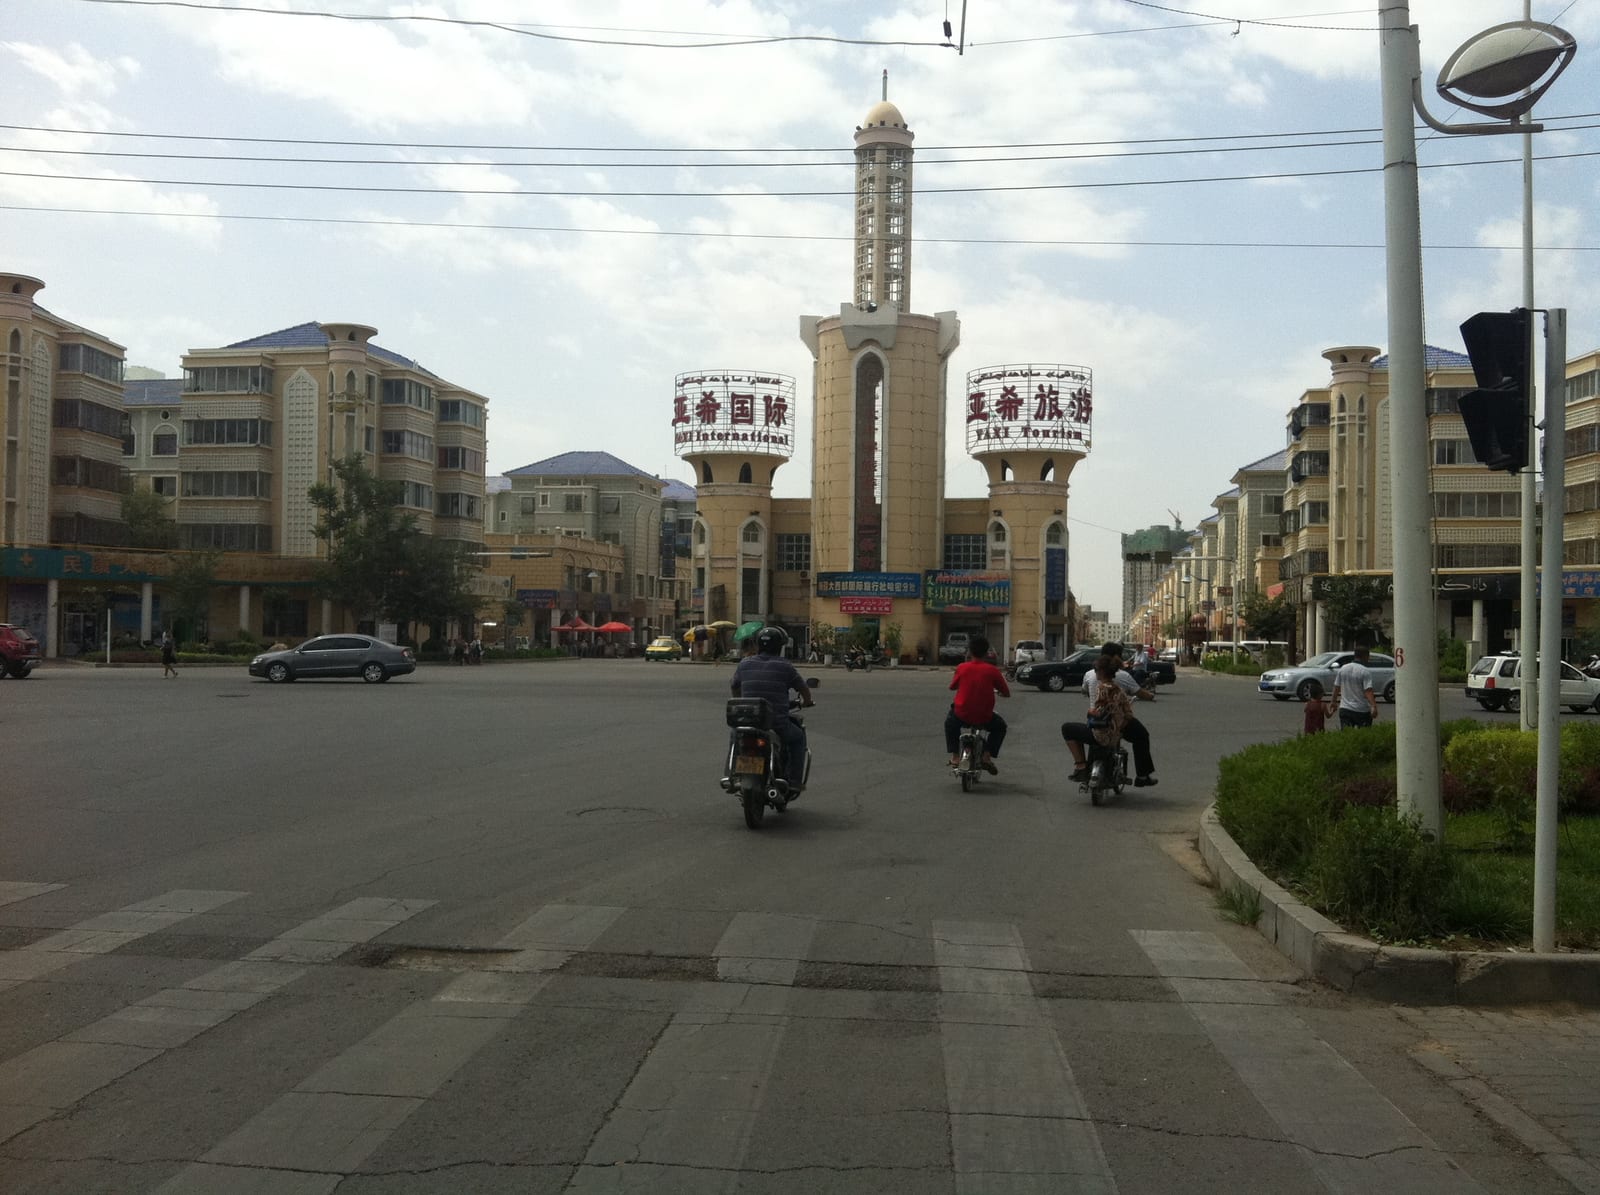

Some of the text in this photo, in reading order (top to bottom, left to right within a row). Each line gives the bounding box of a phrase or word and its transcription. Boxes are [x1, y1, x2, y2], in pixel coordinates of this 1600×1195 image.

[672, 390, 788, 428] 亚希国际
[966, 383, 1093, 424] 亚希旅游
[696, 430, 789, 446] International
[1021, 426, 1083, 441] Tourism
[1395, 647, 1404, 667] 6
